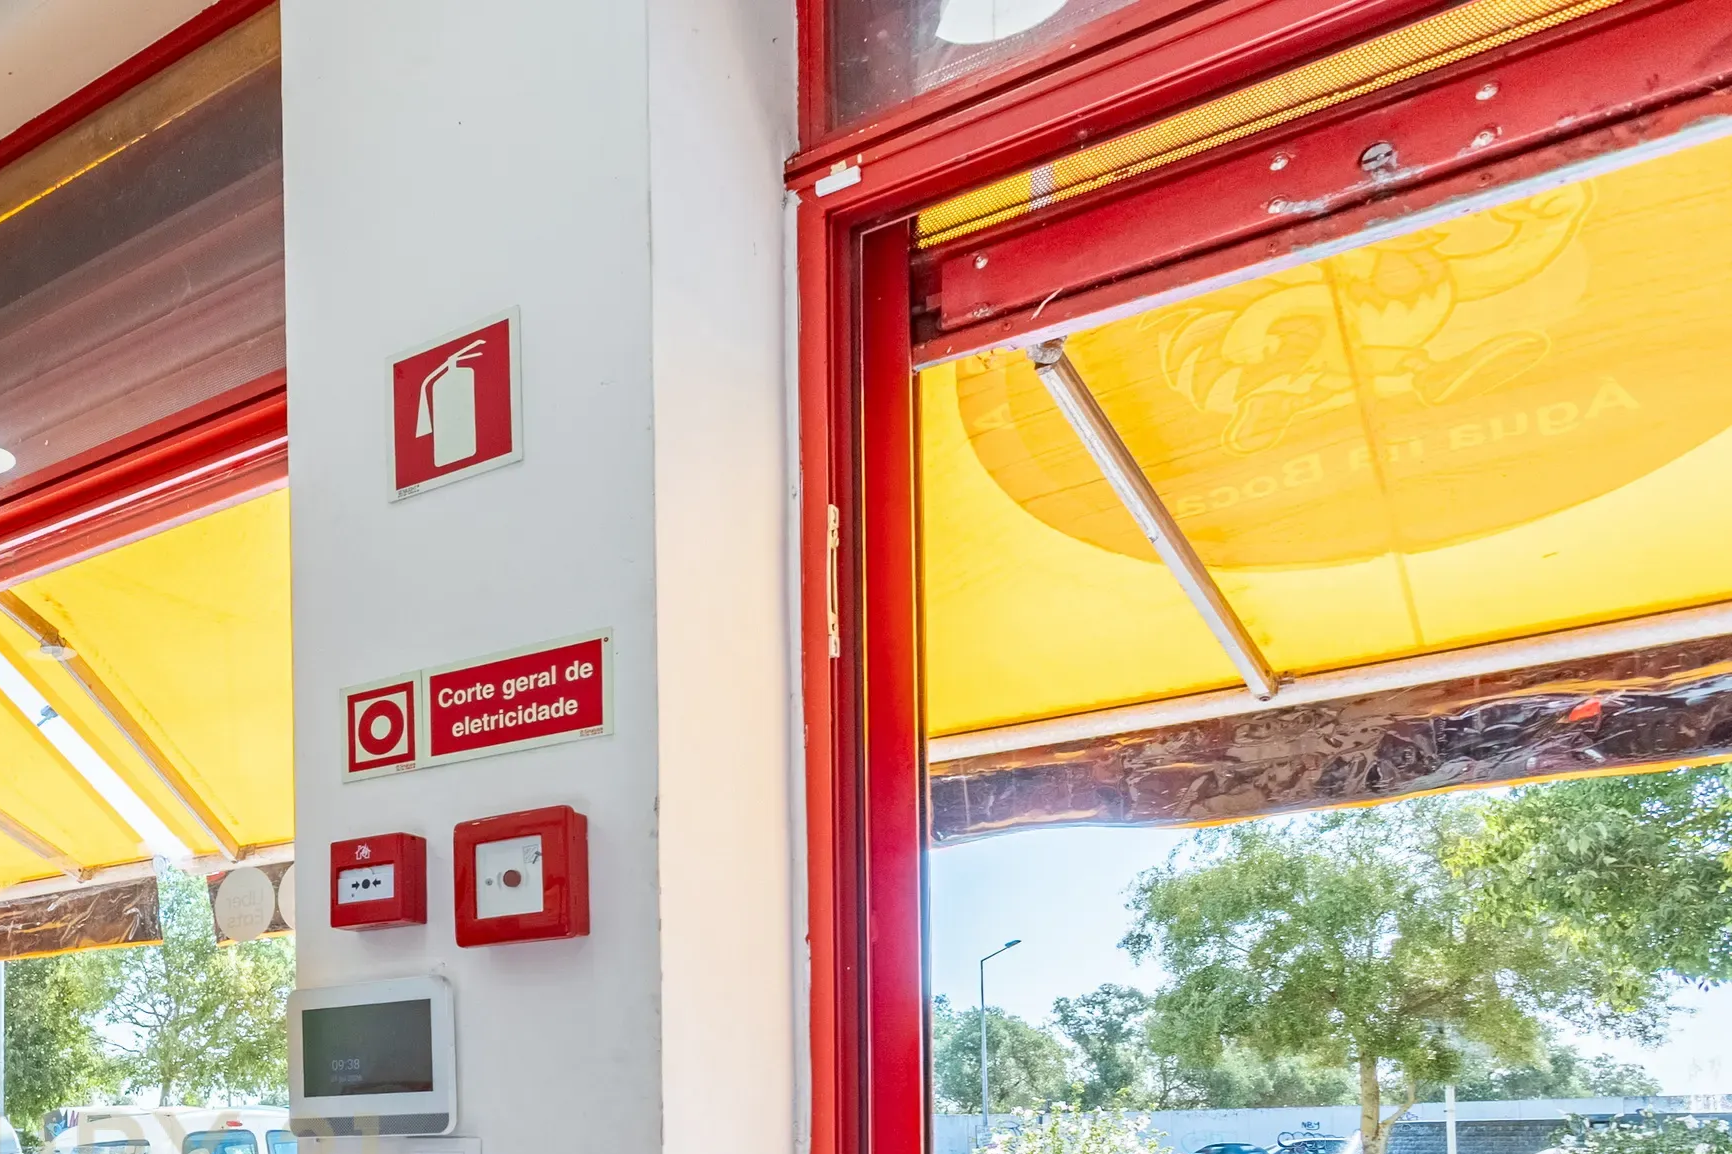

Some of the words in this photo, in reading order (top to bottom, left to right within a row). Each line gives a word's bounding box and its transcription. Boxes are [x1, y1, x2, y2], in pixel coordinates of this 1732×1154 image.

[437, 682, 495, 708] Corte
[502, 664, 557, 700] geral
[564, 660, 594, 682] de
[451, 697, 579, 738] eletricidade
[331, 1058, 360, 1071] 09:38
